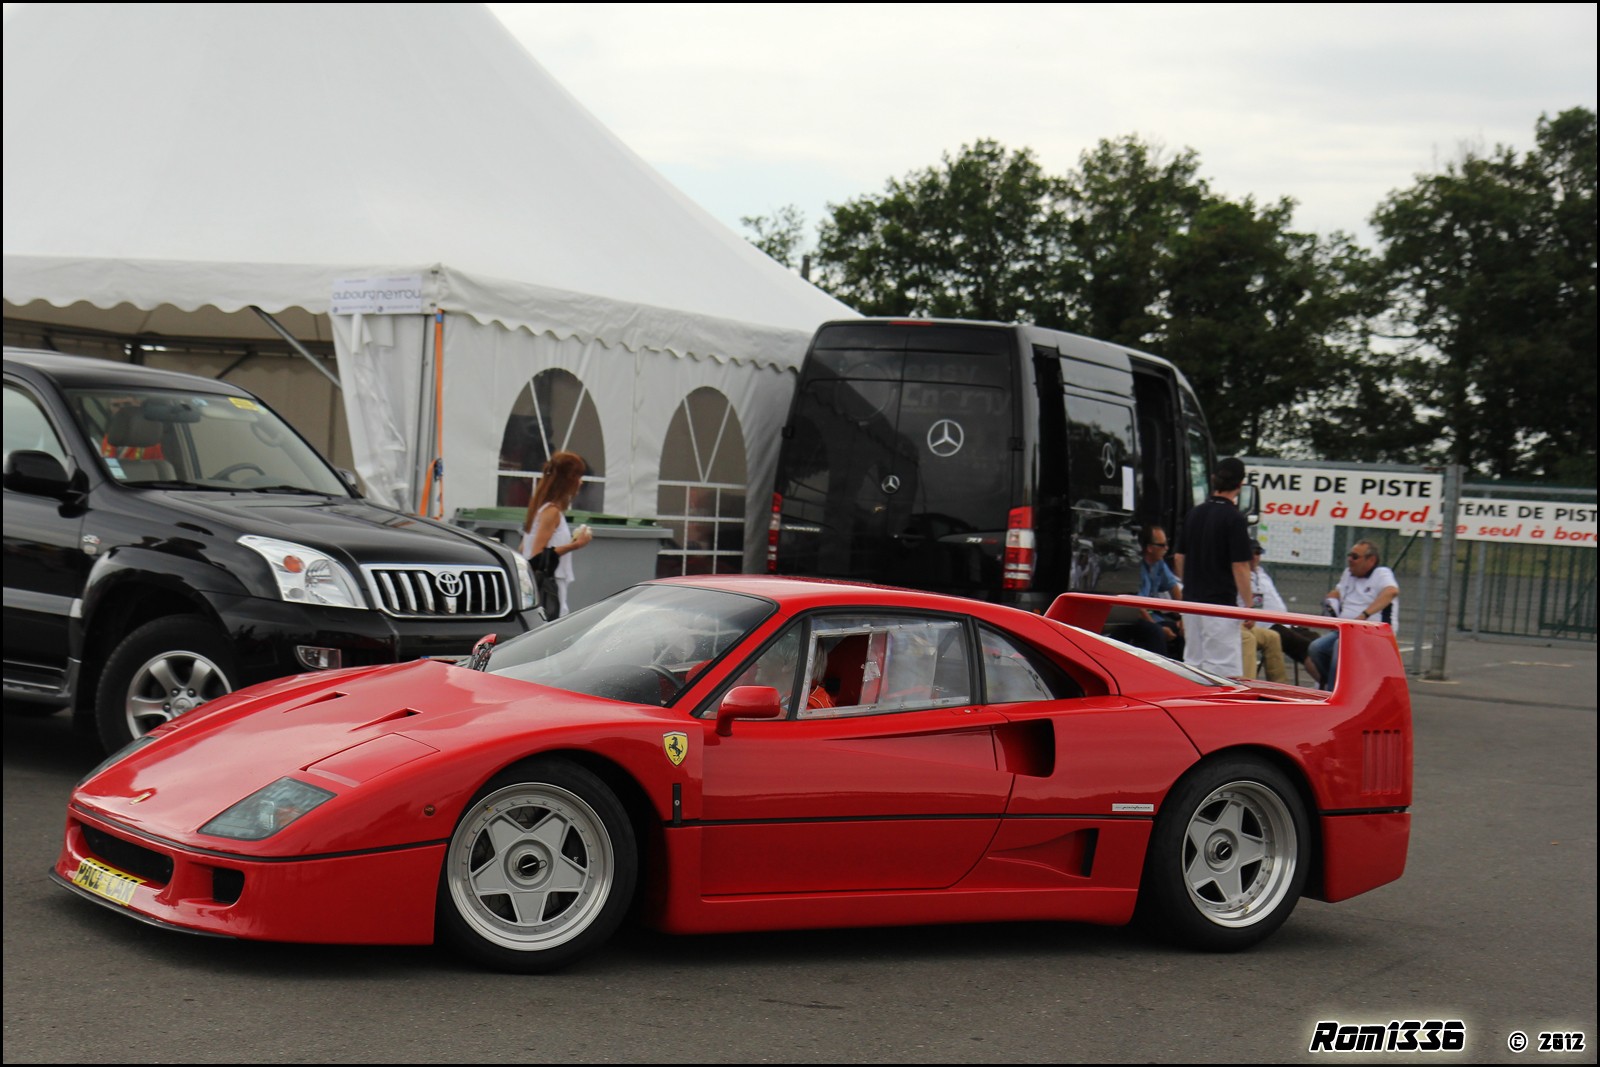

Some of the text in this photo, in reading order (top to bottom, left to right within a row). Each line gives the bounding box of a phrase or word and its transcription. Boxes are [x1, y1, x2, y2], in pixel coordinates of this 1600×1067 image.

[1313, 476, 1347, 494] DE
[1360, 478, 1432, 499] PISTE
[1263, 499, 1431, 524] seul à bord
[1518, 505, 1544, 520] DE
[1477, 523, 1522, 538] seul
[1530, 525, 1545, 539] à
